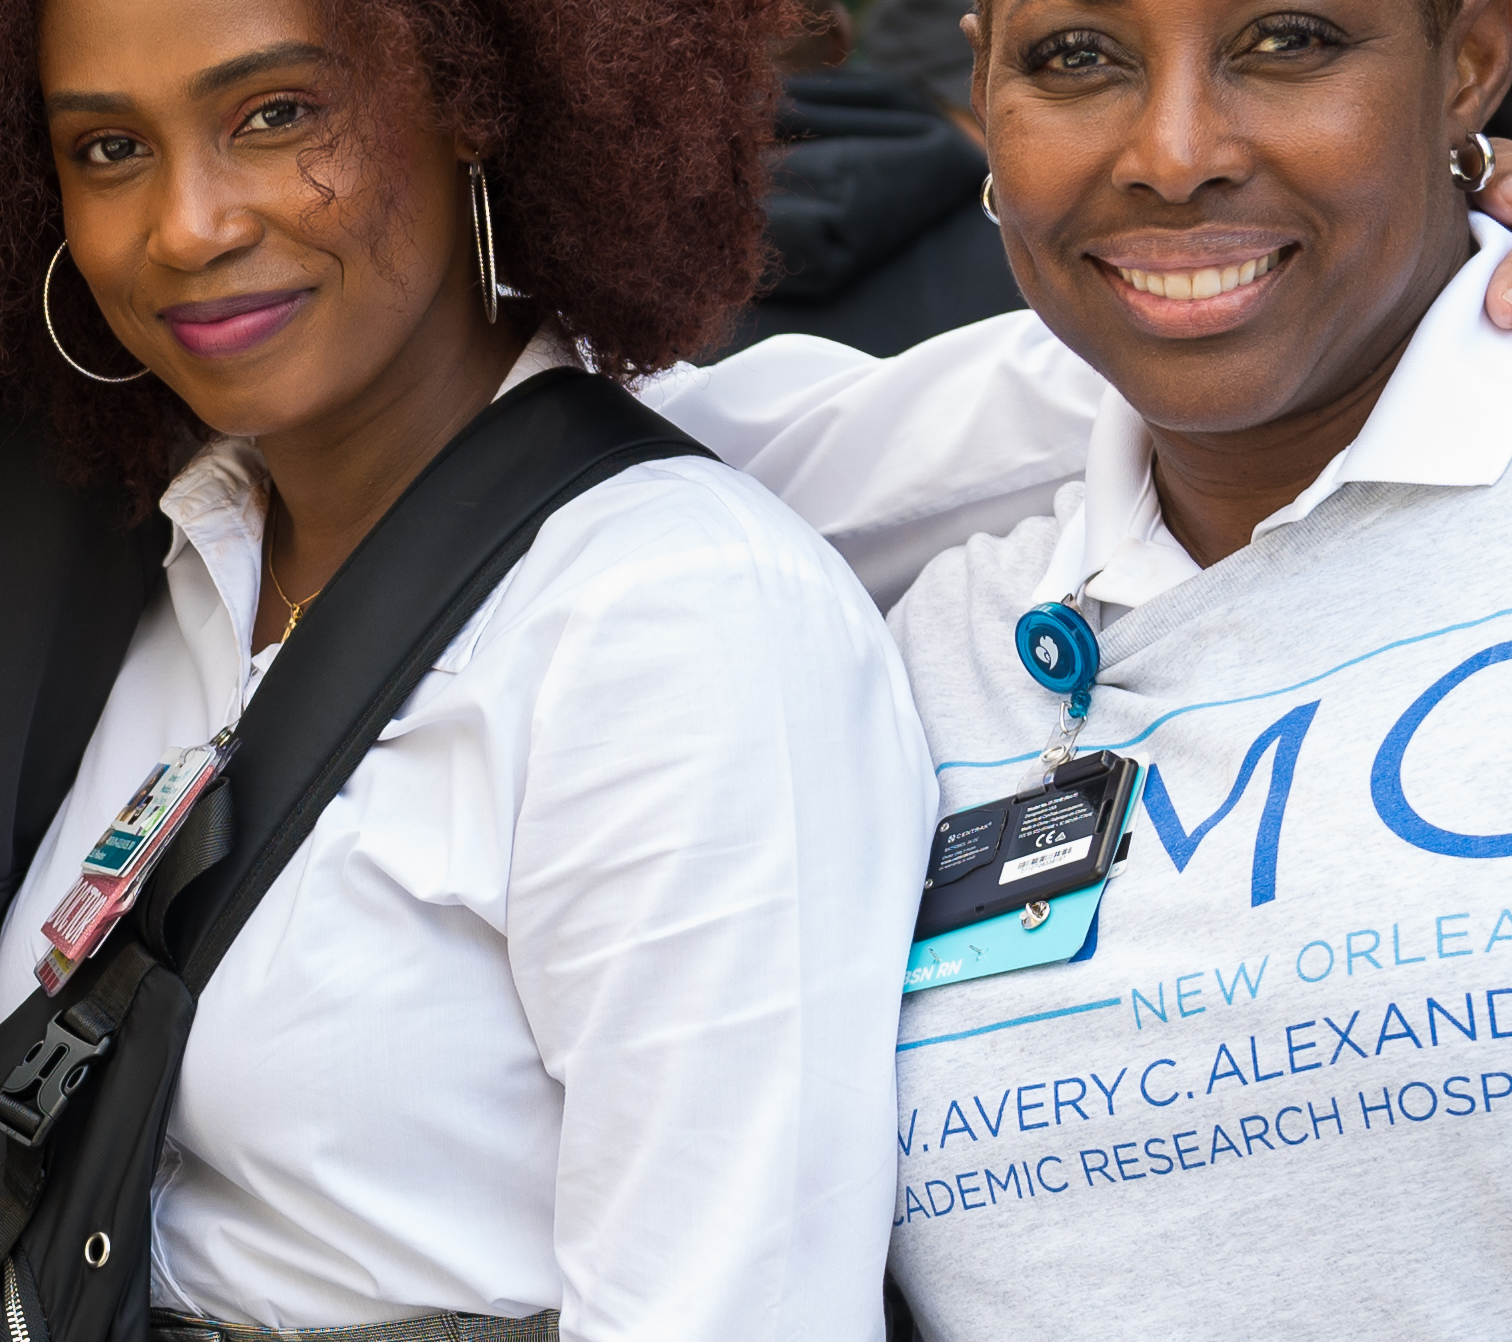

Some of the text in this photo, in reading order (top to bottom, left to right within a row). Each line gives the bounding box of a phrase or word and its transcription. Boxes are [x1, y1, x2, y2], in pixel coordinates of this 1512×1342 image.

[47, 876, 108, 945] DOCTOR
[936, 958, 963, 979] RN
[1130, 954, 1271, 1030] NEW
[940, 1066, 1128, 1151] AVERY
[1140, 1058, 1194, 1109] C.
[1080, 1097, 1345, 1189] RESEARCH
